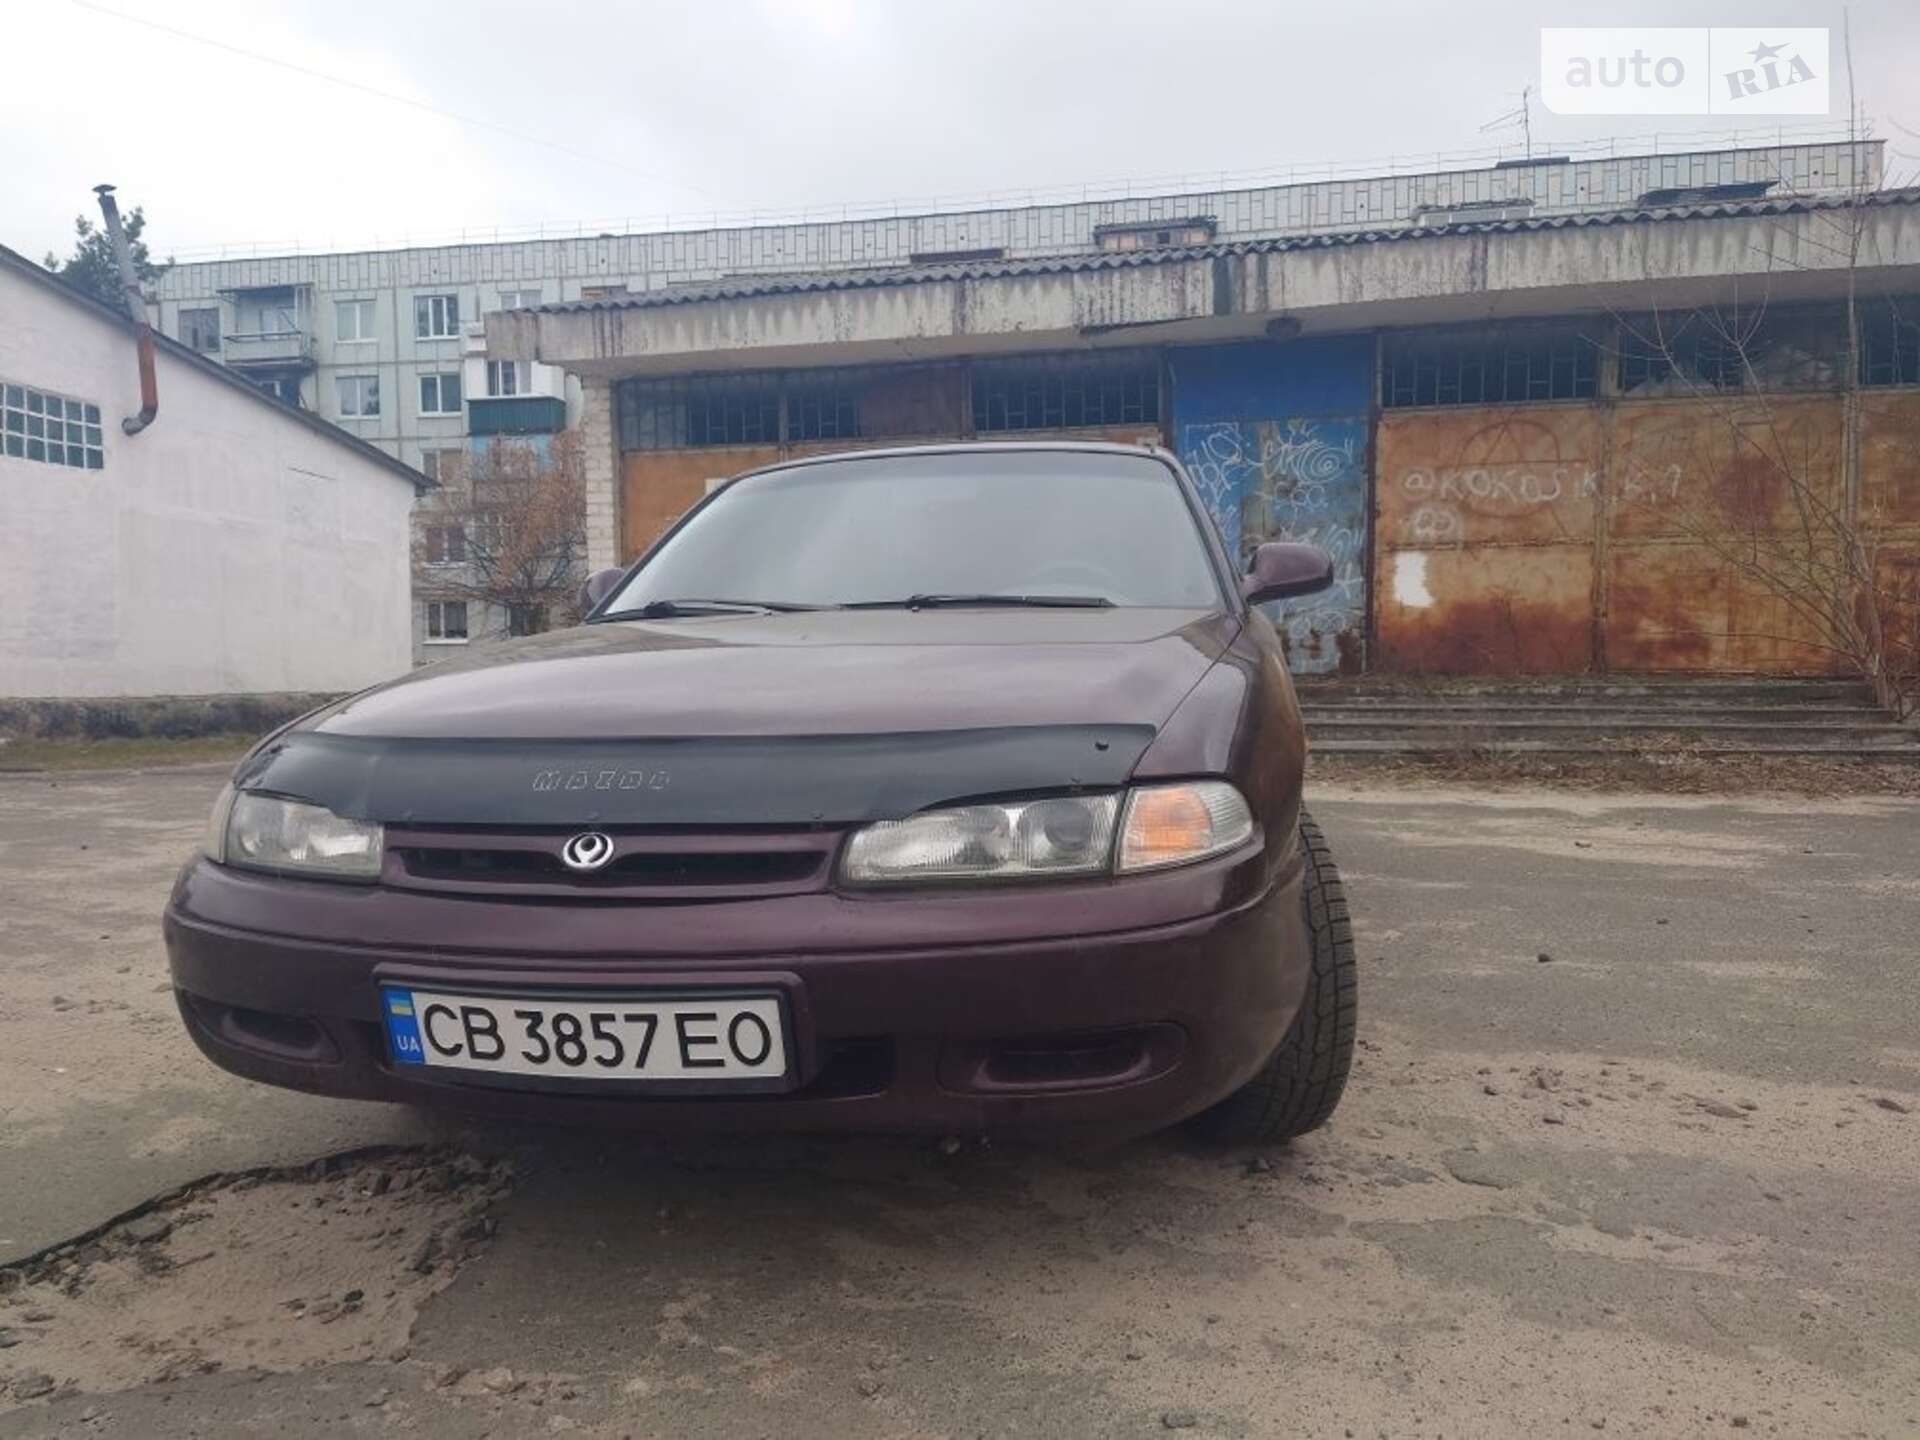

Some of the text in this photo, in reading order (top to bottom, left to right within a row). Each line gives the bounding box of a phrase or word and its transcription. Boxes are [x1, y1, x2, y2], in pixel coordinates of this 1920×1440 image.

[532, 770, 671, 792] MAZDA
[397, 1035, 421, 1054] UA
[423, 1003, 772, 1069] CB 3857 EO
